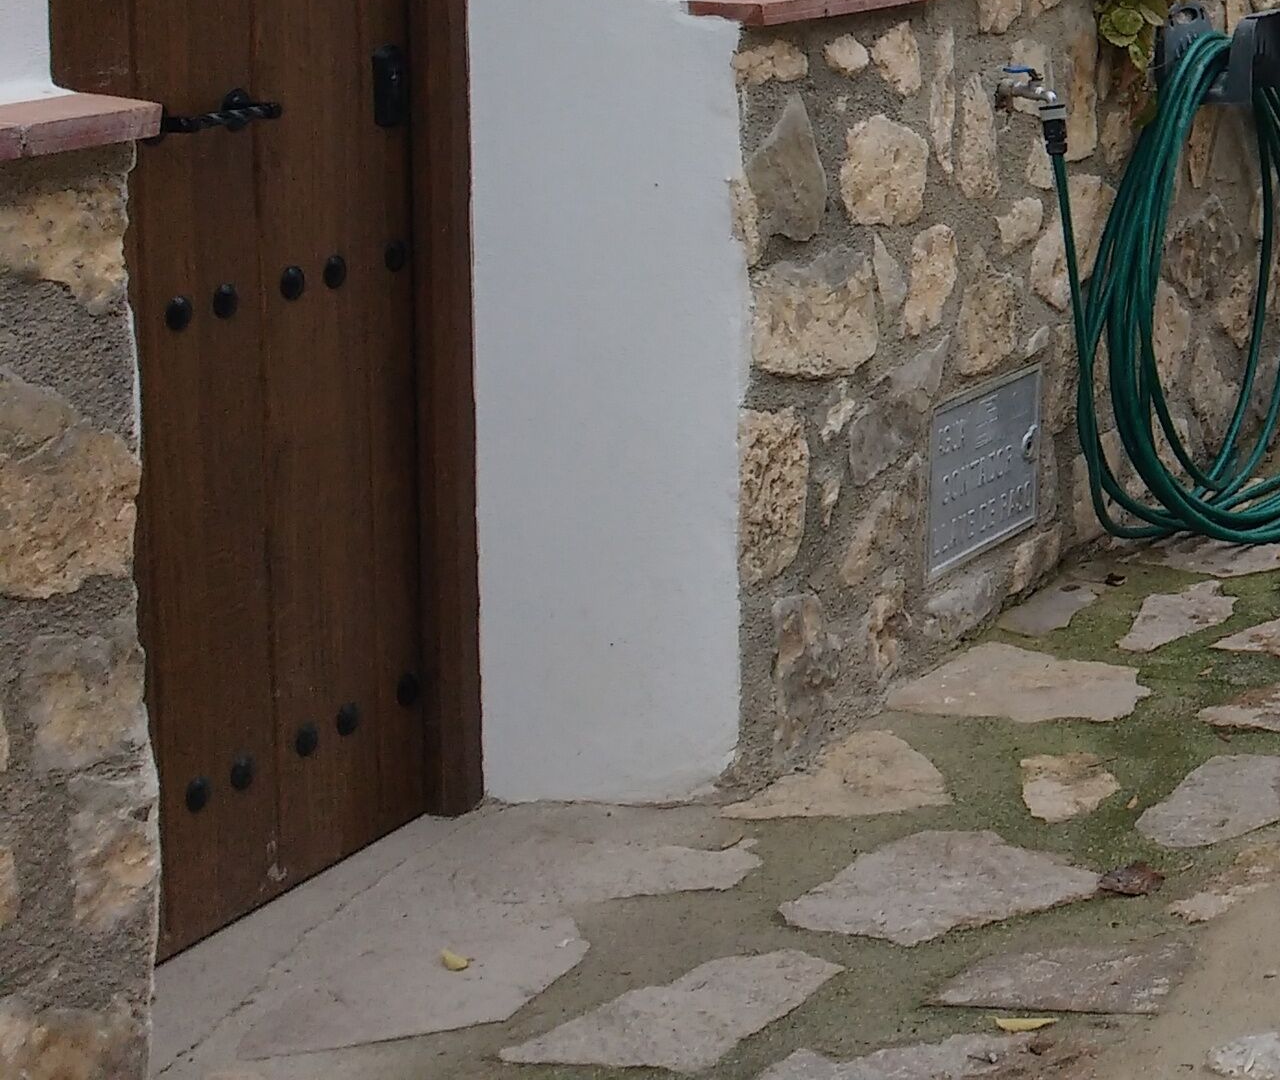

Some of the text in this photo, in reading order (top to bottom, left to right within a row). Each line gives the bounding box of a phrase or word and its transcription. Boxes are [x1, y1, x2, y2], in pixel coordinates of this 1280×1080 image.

[942, 444, 1014, 506] CONTADOR
[933, 480, 1032, 557] LLAVE DE PASO
